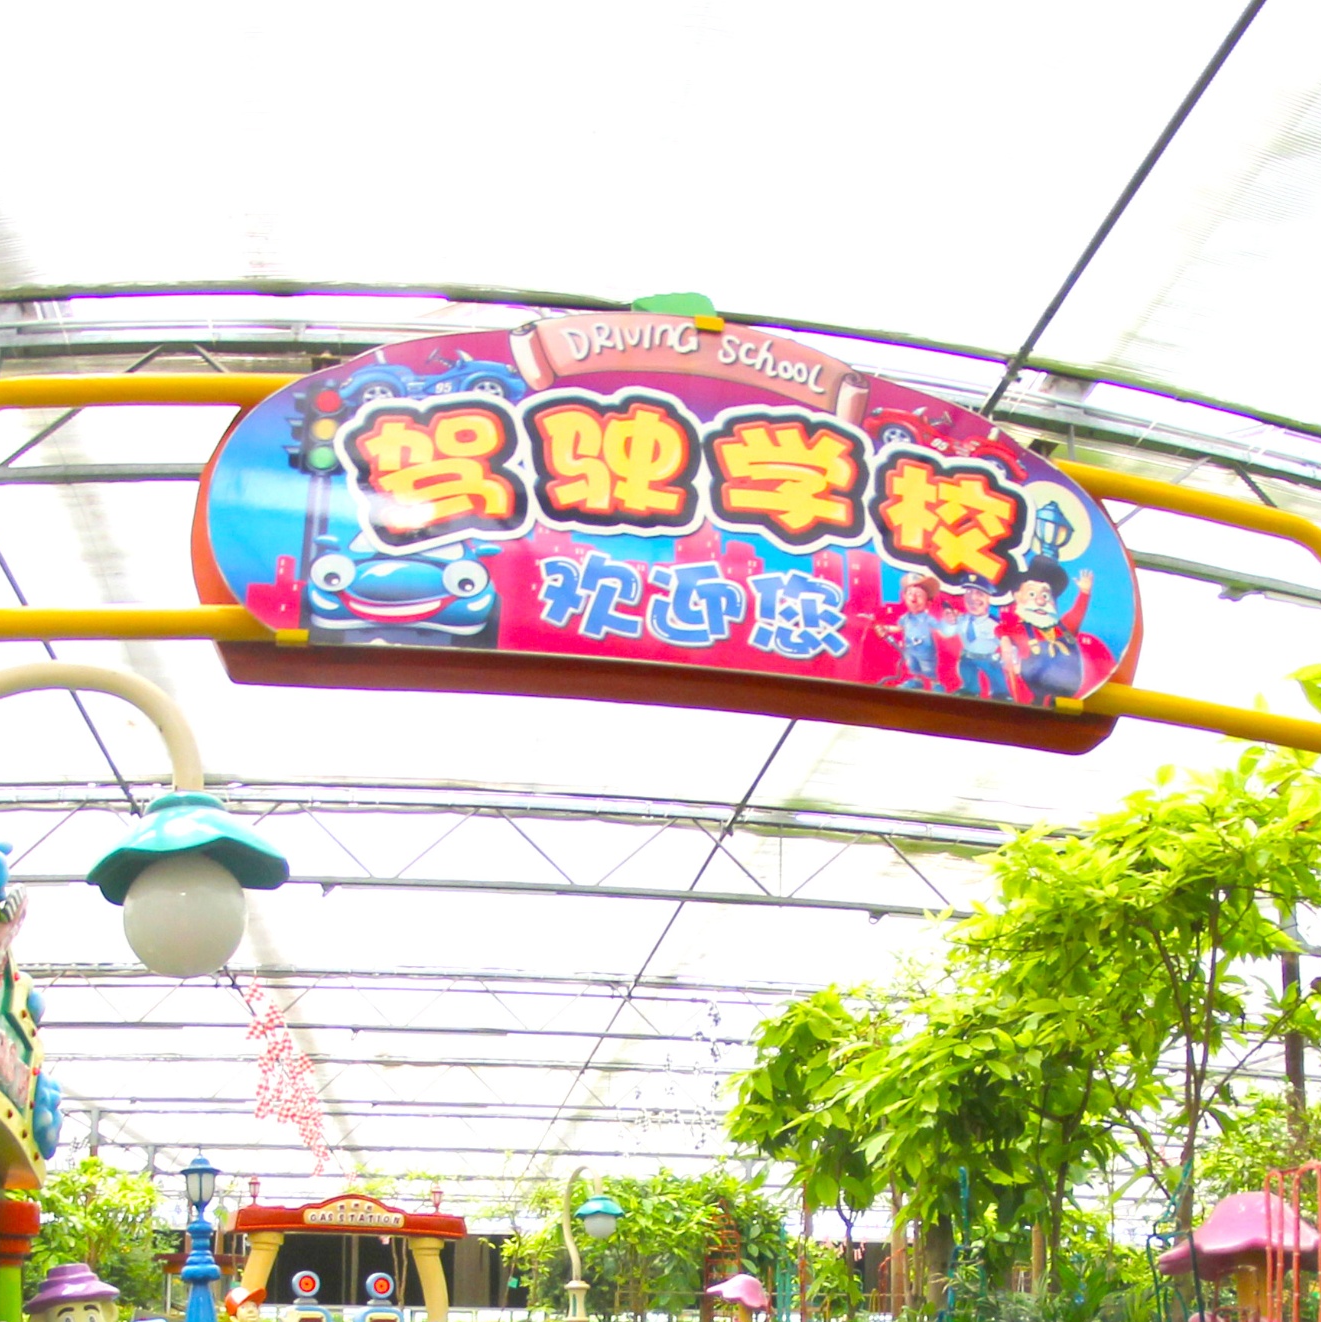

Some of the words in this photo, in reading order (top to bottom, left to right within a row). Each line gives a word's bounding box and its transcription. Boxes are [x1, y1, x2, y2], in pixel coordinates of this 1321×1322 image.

[561, 321, 701, 361] DRIVING
[355, 402, 1018, 584] 驾驶学校
[538, 550, 850, 660] 欢迎您
[309, 1213, 334, 1222] GAS
[339, 1213, 401, 1225] STATION
